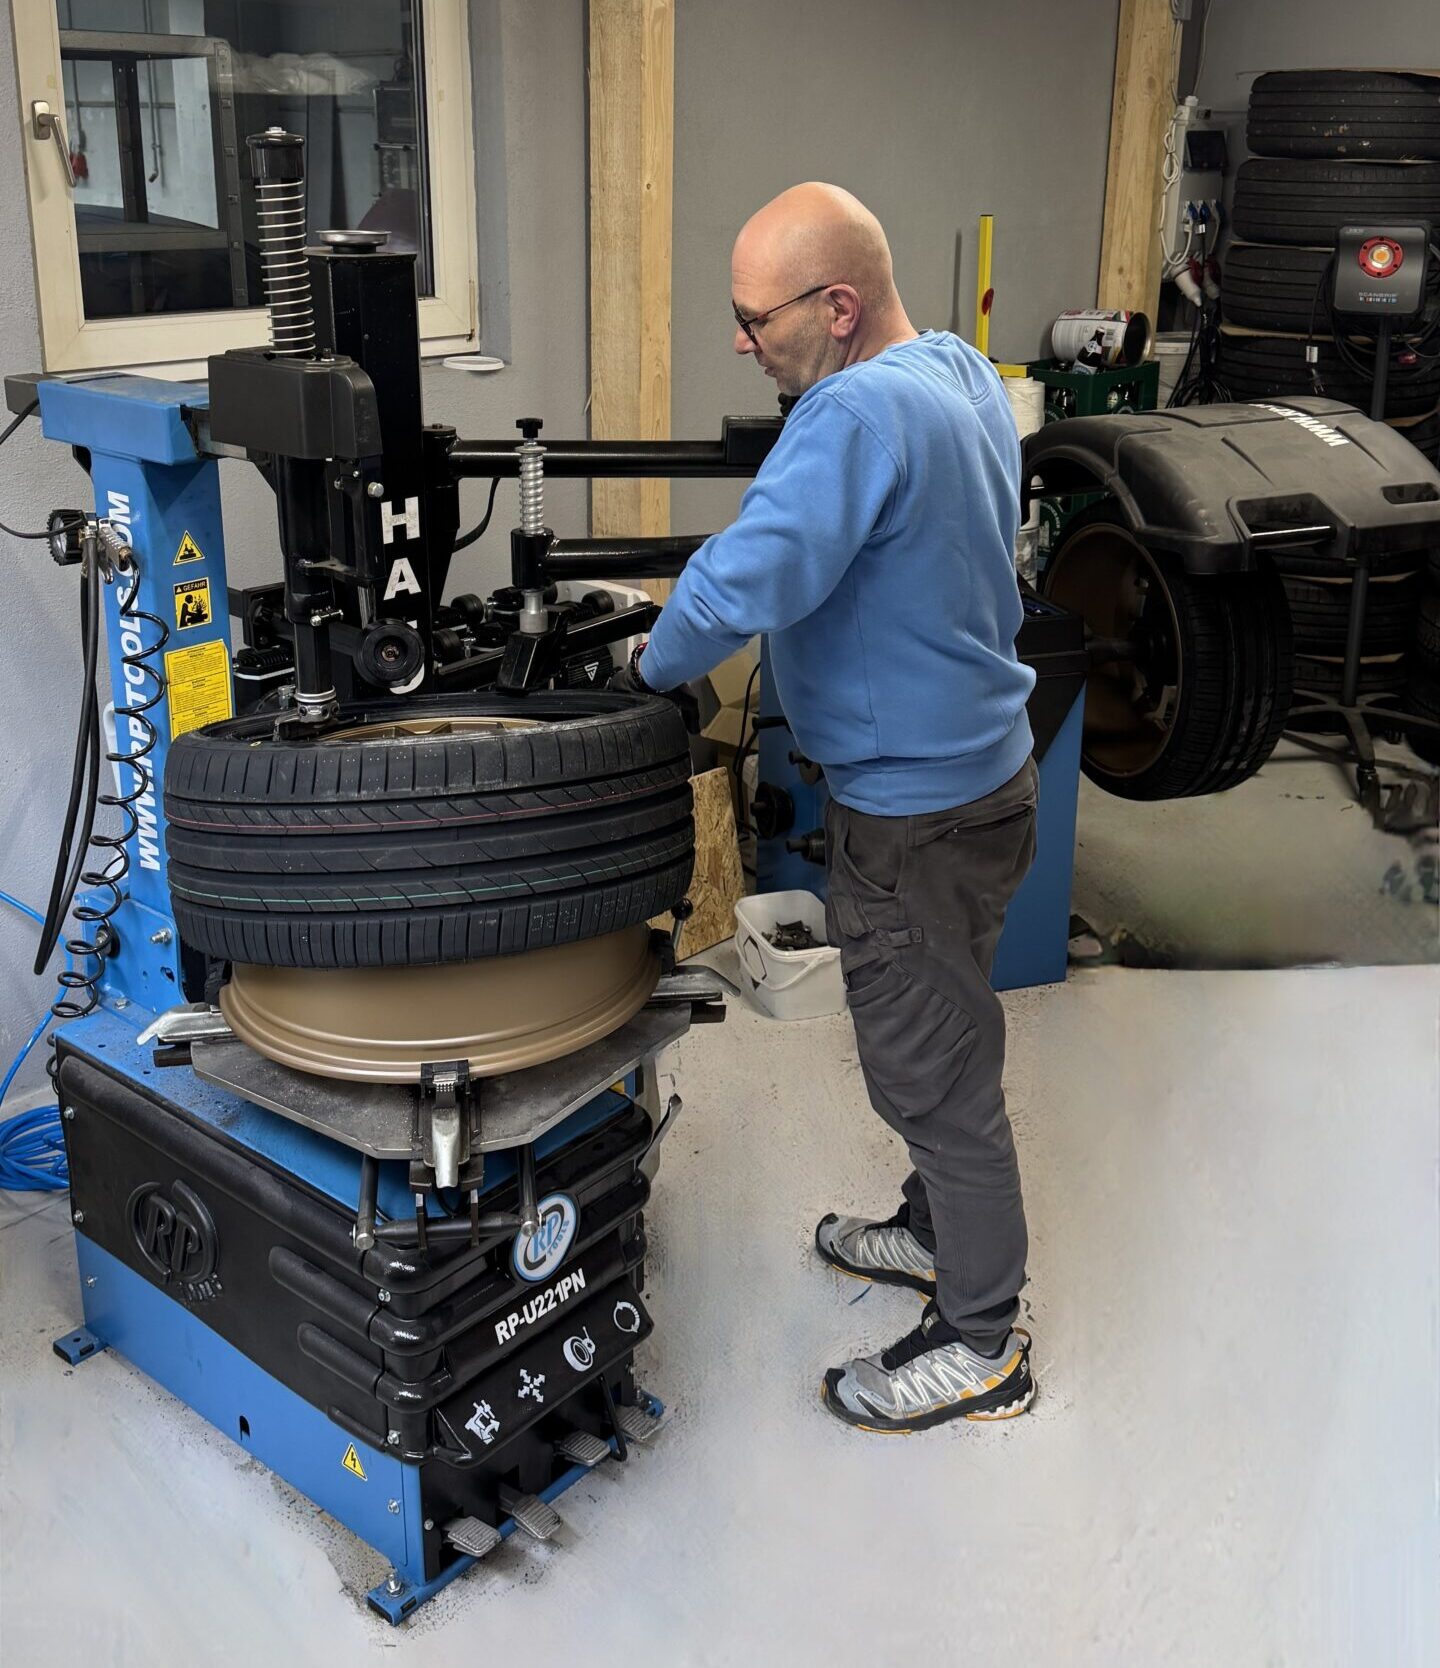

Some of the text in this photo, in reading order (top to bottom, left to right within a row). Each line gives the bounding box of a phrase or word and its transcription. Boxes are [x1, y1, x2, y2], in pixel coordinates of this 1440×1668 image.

[182, 580, 207, 592] GEFAHR
[107, 490, 161, 871] WWW.RPTOOLS.OM
[530, 1213, 560, 1261] RP
[546, 1219, 570, 1256] TOOLS
[494, 1267, 587, 1346] RP-U221PN
